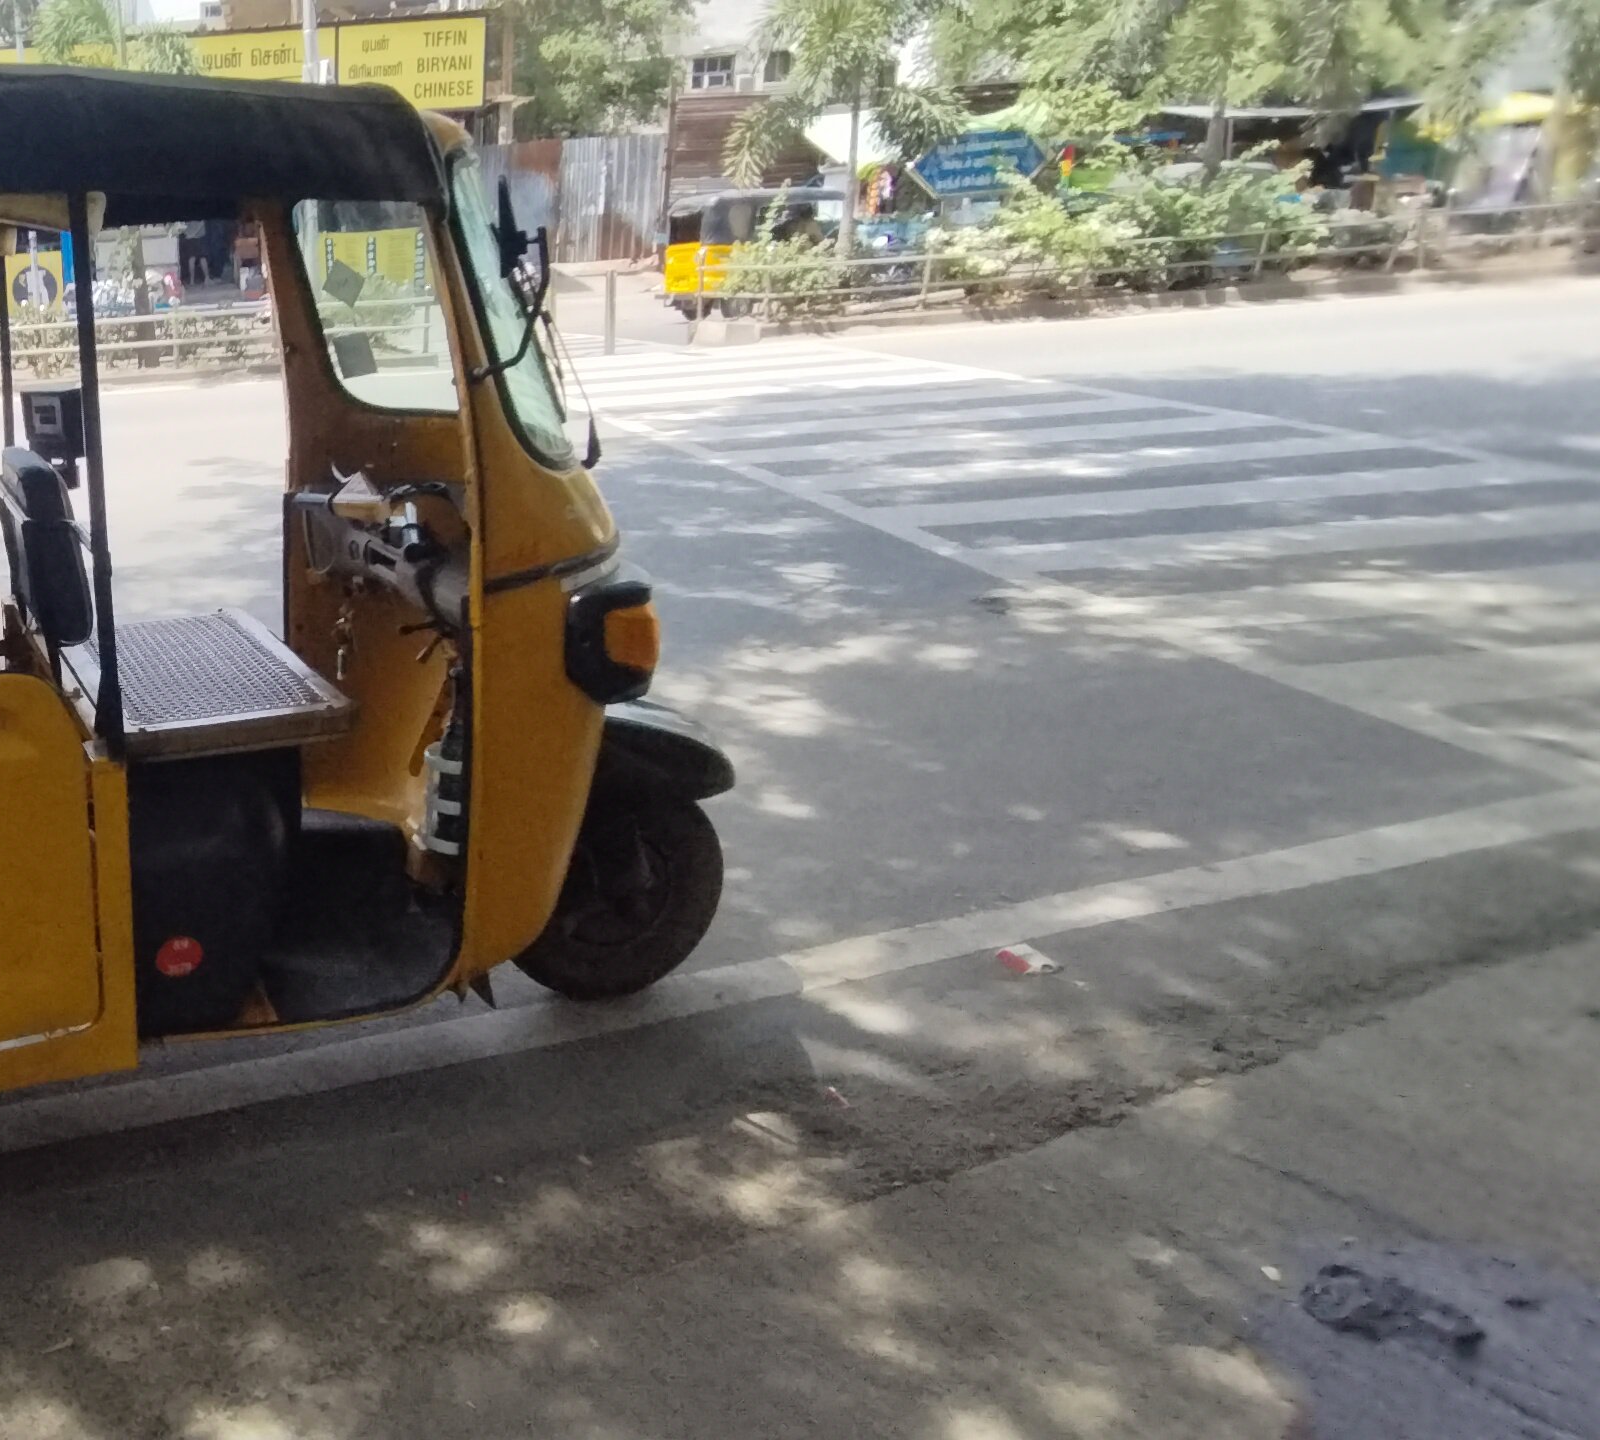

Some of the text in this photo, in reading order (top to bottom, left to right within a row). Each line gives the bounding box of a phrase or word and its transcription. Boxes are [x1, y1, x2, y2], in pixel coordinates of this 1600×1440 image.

[361, 34, 390, 54] டிபன்
[423, 30, 468, 48] TIFFIN
[250, 43, 304, 66] சென்ட
[416, 55, 473, 74] BIRYANI
[414, 80, 474, 99] CHINESE
